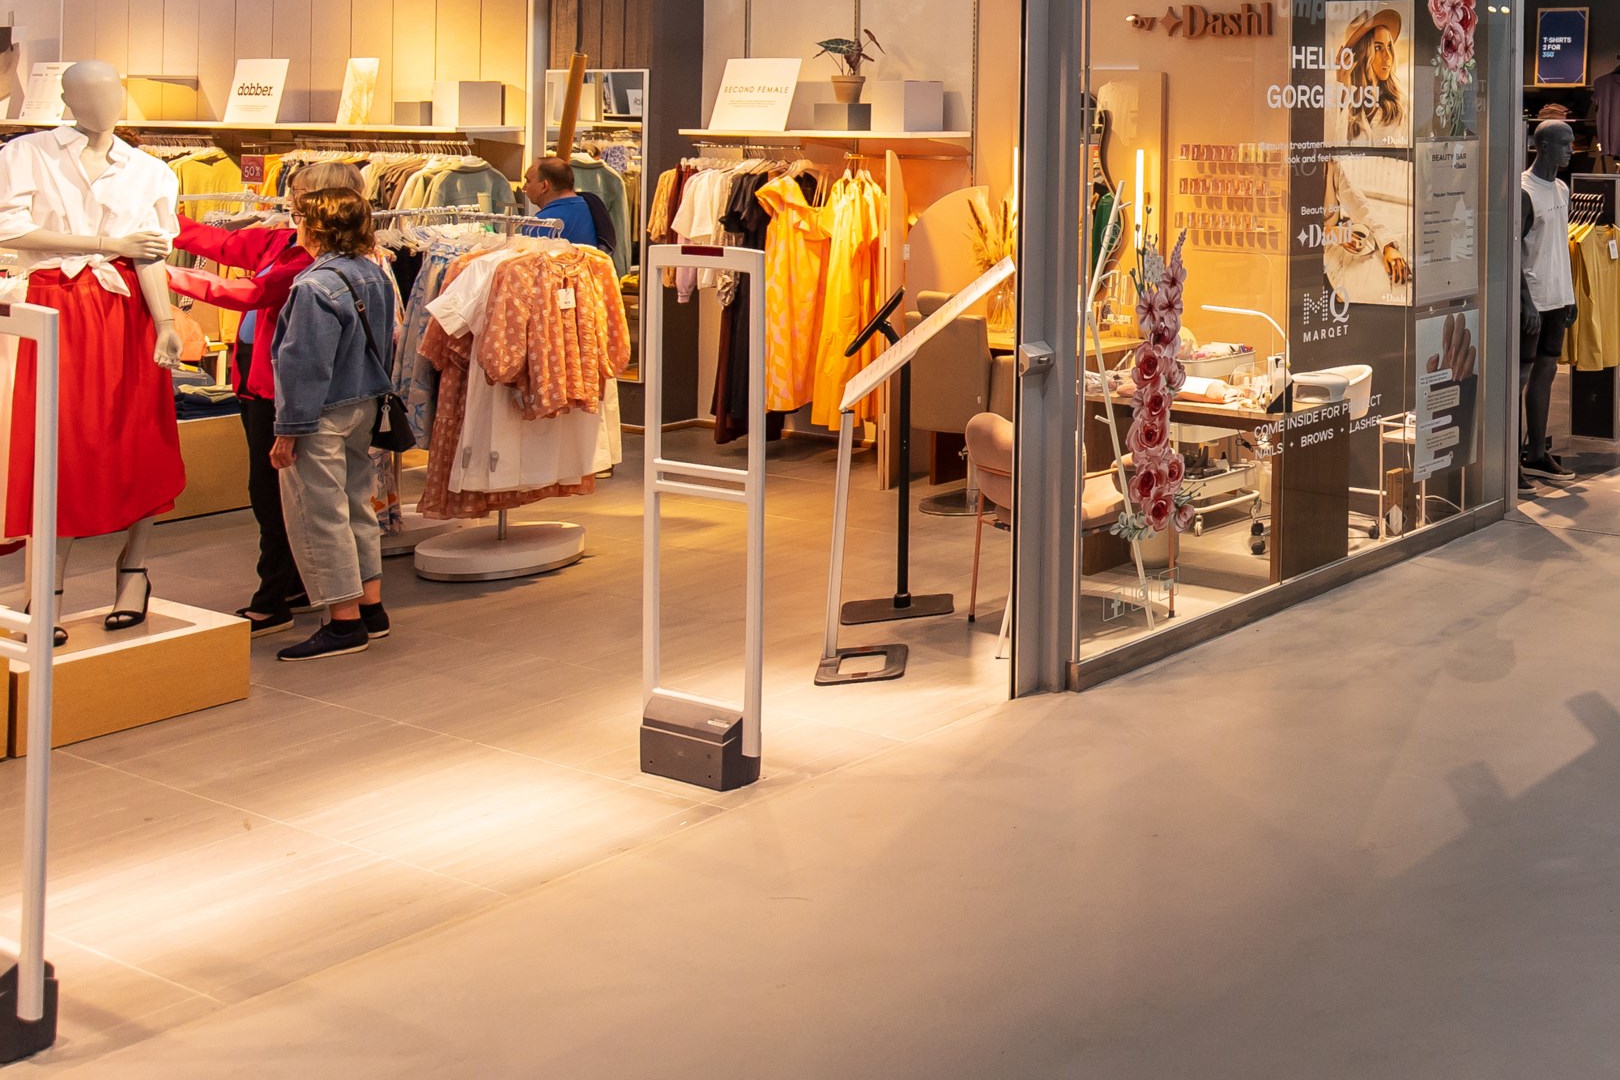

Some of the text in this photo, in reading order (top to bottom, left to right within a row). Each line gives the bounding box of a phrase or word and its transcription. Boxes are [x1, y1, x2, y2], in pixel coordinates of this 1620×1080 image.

[1292, 45, 1355, 70] HELLO
[724, 85, 790, 94] SECOND FEMALE
[1266, 84, 1380, 110] GORGEOUS!
[1302, 153, 1316, 163] and
[1317, 152, 1331, 162] feel
[1431, 152, 1467, 162] BEAUTY BAR
[1301, 206, 1325, 216] Beauty
[1303, 286, 1350, 325] MQ
[1303, 325, 1349, 343] MARQET
[1254, 419, 1284, 439] COME
[1287, 410, 1319, 430] INSIDE
[1321, 404, 1341, 421] FOR
[1255, 414, 1382, 460] NAILS BROWS LASHES
